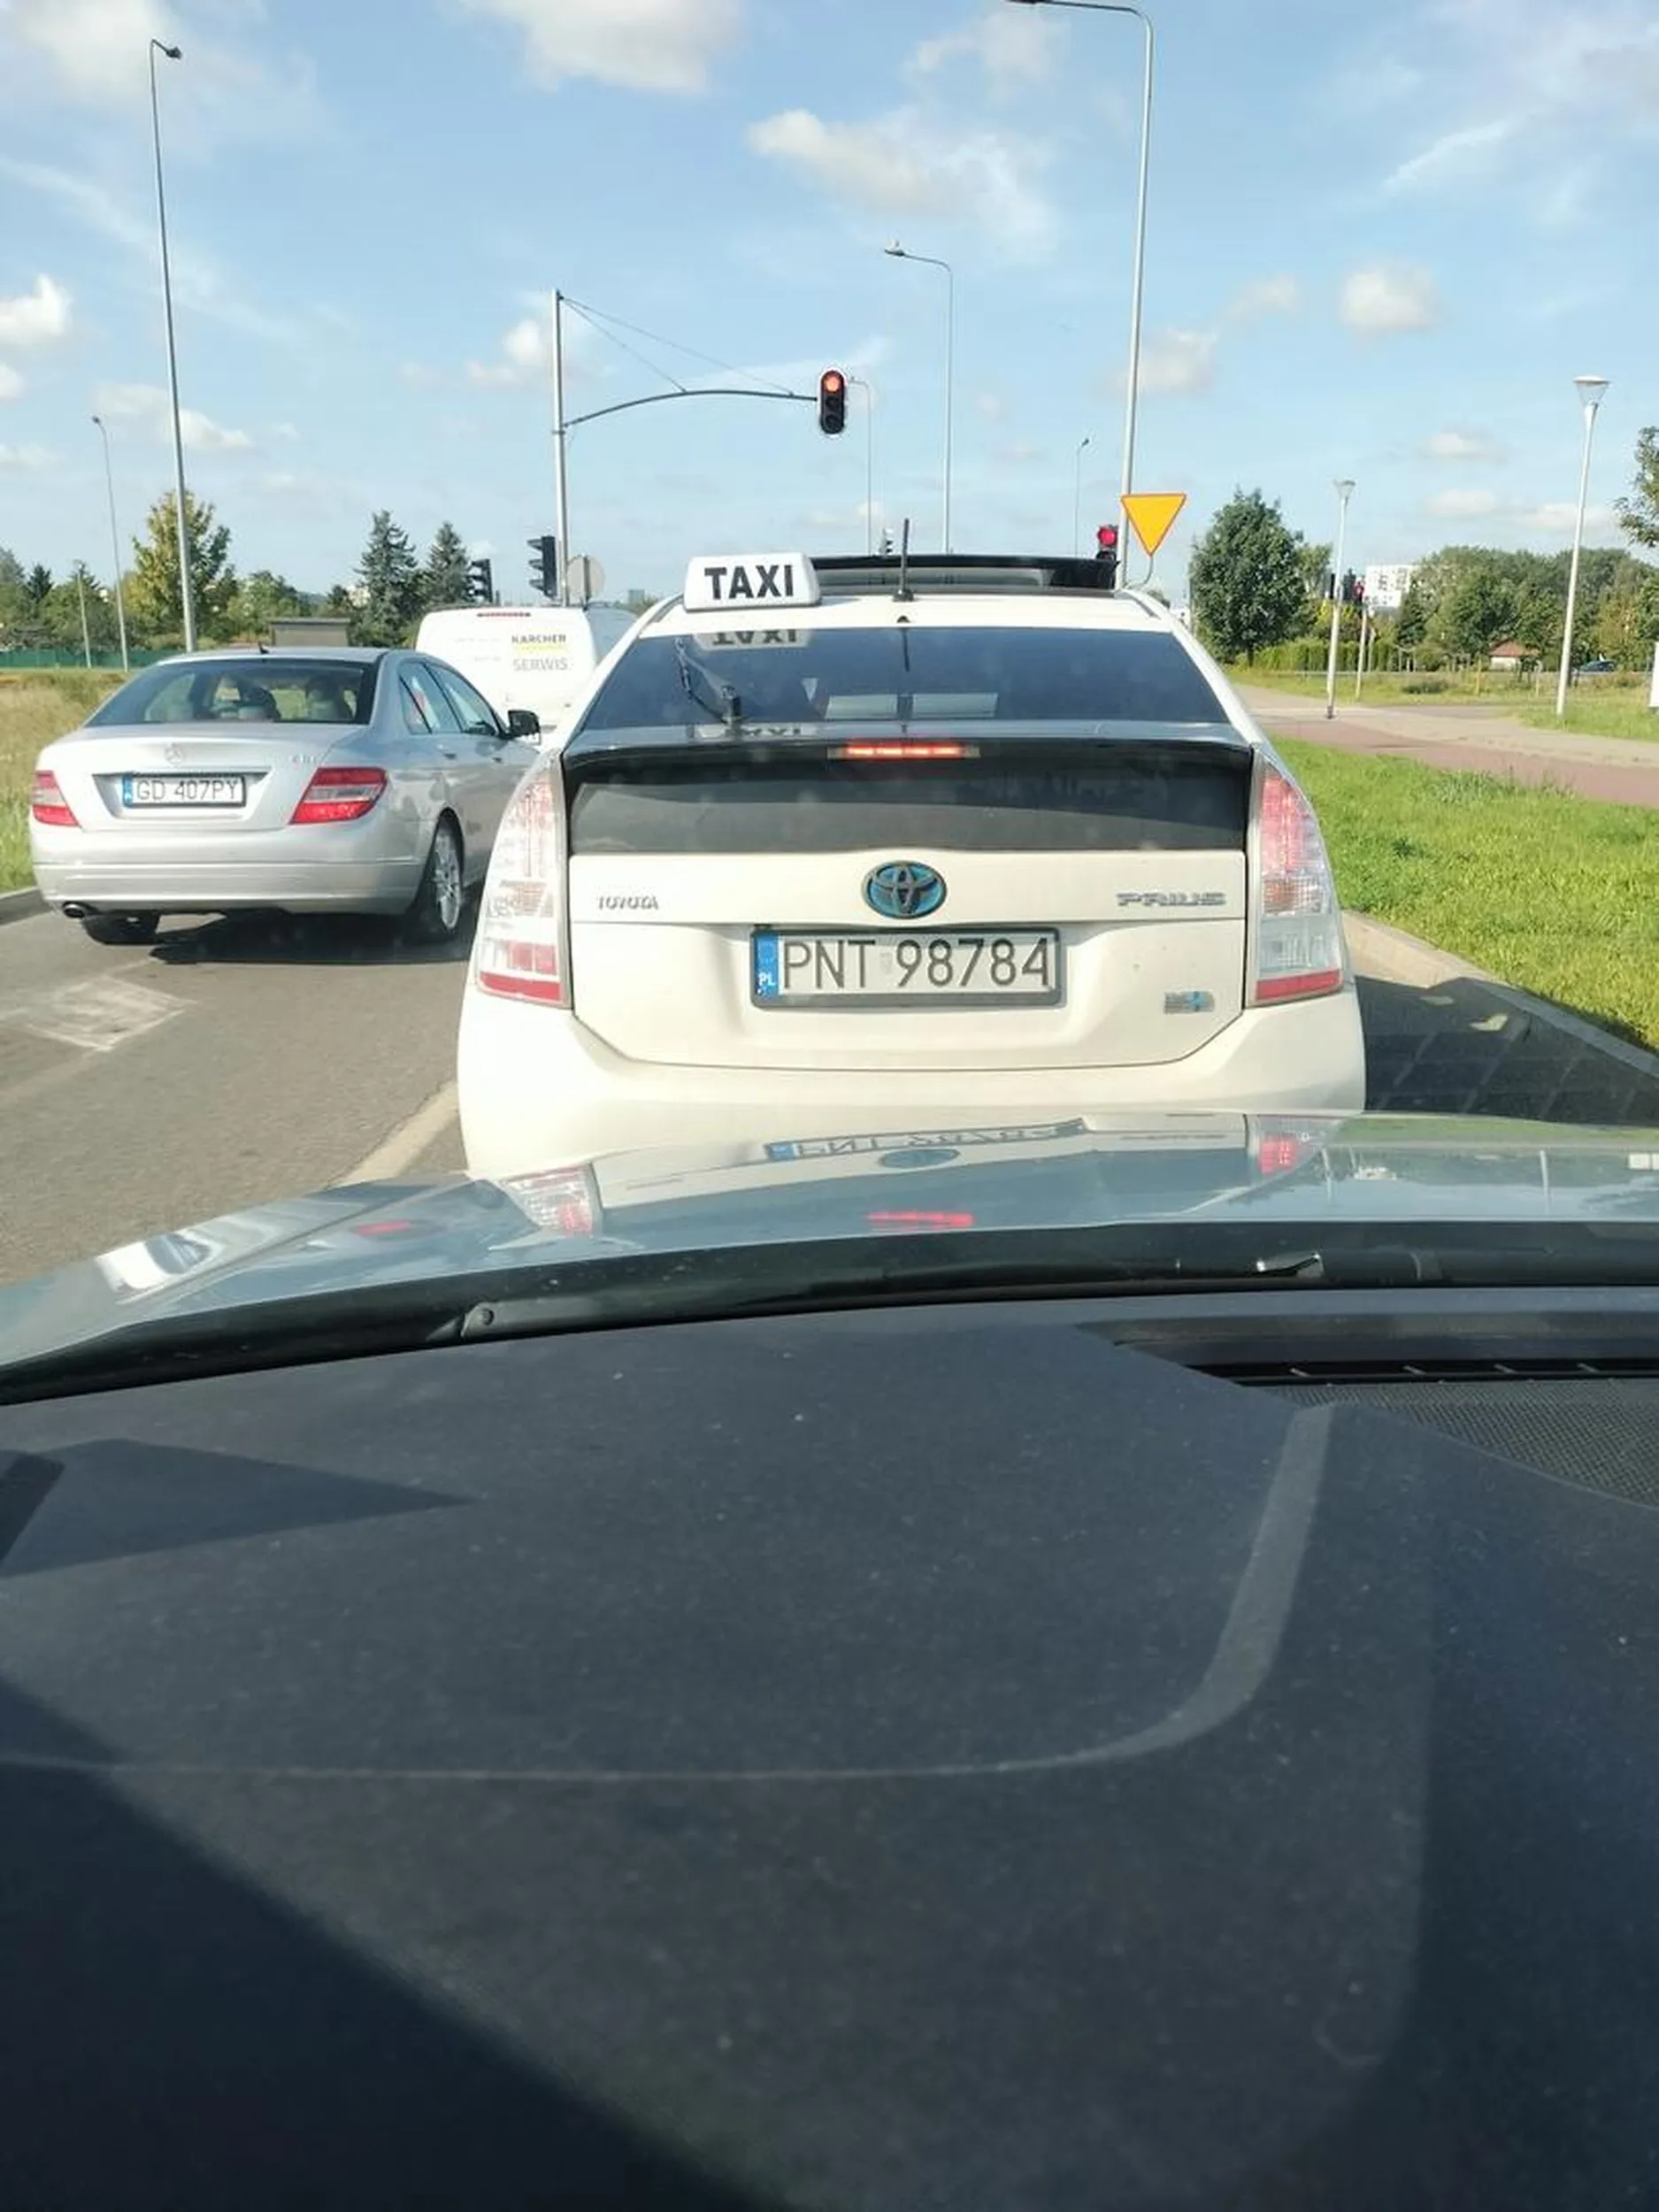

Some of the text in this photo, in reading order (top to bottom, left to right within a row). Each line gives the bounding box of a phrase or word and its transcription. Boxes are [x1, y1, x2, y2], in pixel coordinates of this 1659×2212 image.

[703, 564, 795, 600] TAXI
[512, 657, 569, 672] SERWIS
[136, 779, 239, 801] GD 407PY
[595, 895, 660, 910] TOYOTA
[1116, 891, 1227, 907] PRIUS
[783, 938, 1050, 989] PNT 98784
[758, 972, 776, 987] PL
